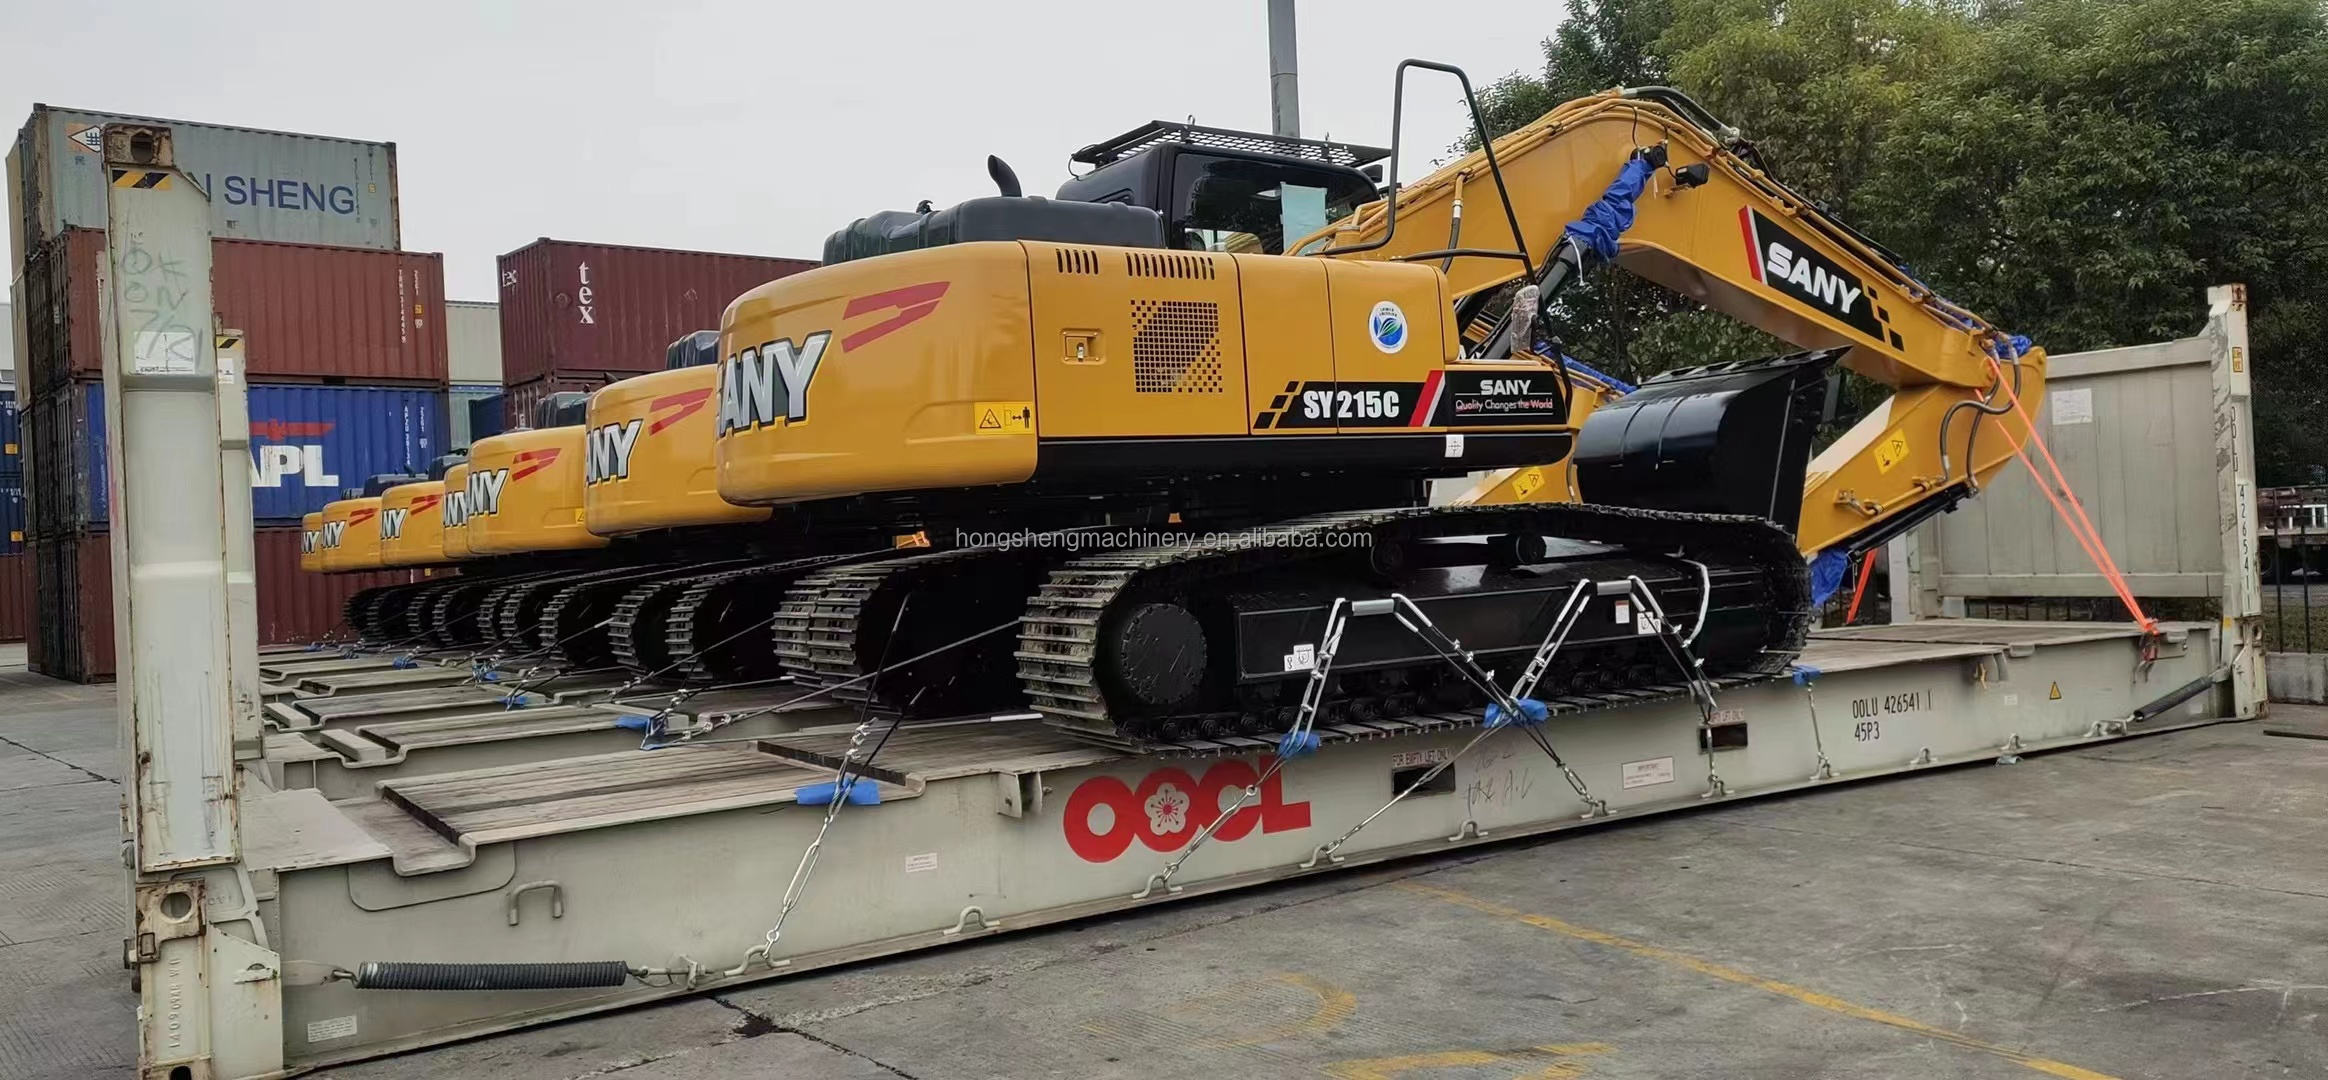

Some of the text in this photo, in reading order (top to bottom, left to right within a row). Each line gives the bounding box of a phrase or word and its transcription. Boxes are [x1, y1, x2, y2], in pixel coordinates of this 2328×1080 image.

[224, 176, 355, 215] SHENG
[578, 260, 594, 324] tex
[1767, 241, 1861, 314] SANY
[718, 329, 832, 438] ANY
[1479, 380, 1531, 395] SANY
[1455, 398, 1553, 412] Quality Changes the World
[1884, 692, 1920, 714] 426541
[1854, 721, 1880, 742] 45P3
[1063, 755, 1312, 863] OOCL
